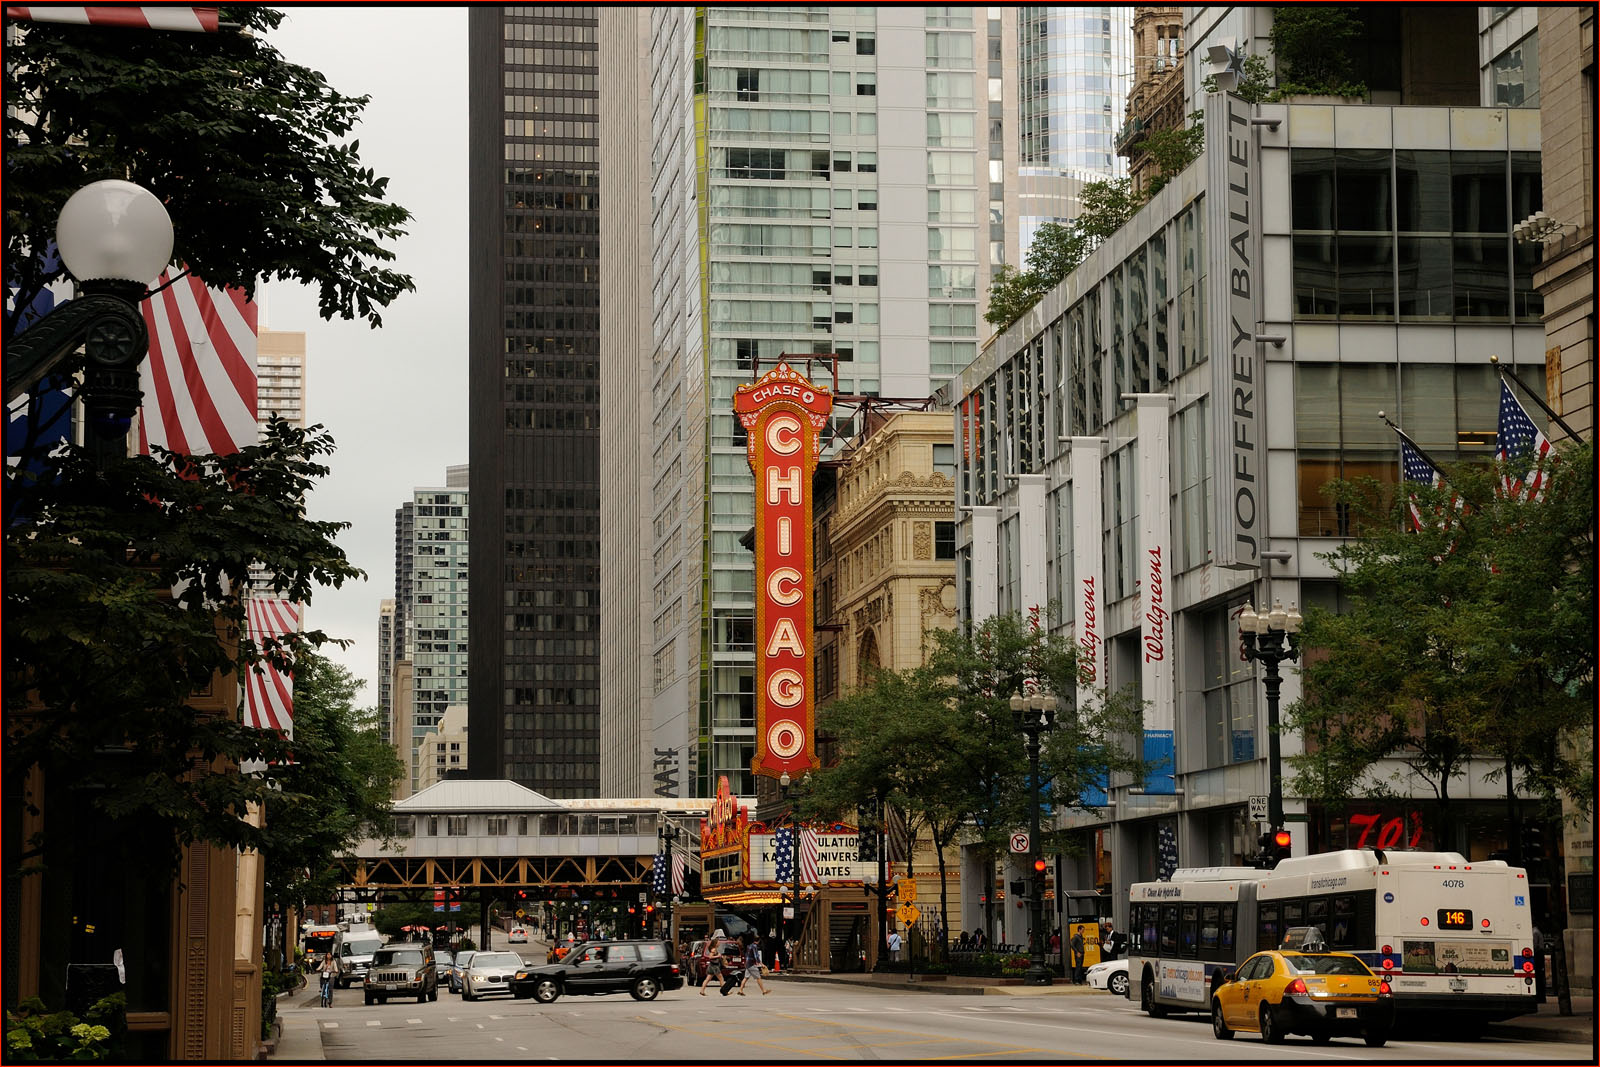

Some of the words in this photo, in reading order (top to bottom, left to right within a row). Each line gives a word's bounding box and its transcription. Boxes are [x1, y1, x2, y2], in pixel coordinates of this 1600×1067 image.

[1228, 101, 1251, 300] BALLET
[753, 385, 801, 403] CHASE
[1232, 315, 1257, 561] JOFFREY
[765, 416, 805, 760] CHICAGO
[1143, 545, 1169, 663] Walgreens
[817, 866, 851, 876] UATES
[1442, 880, 1465, 888] 4078
[1446, 911, 1465, 924] 146
[1367, 979, 1380, 987] 885
